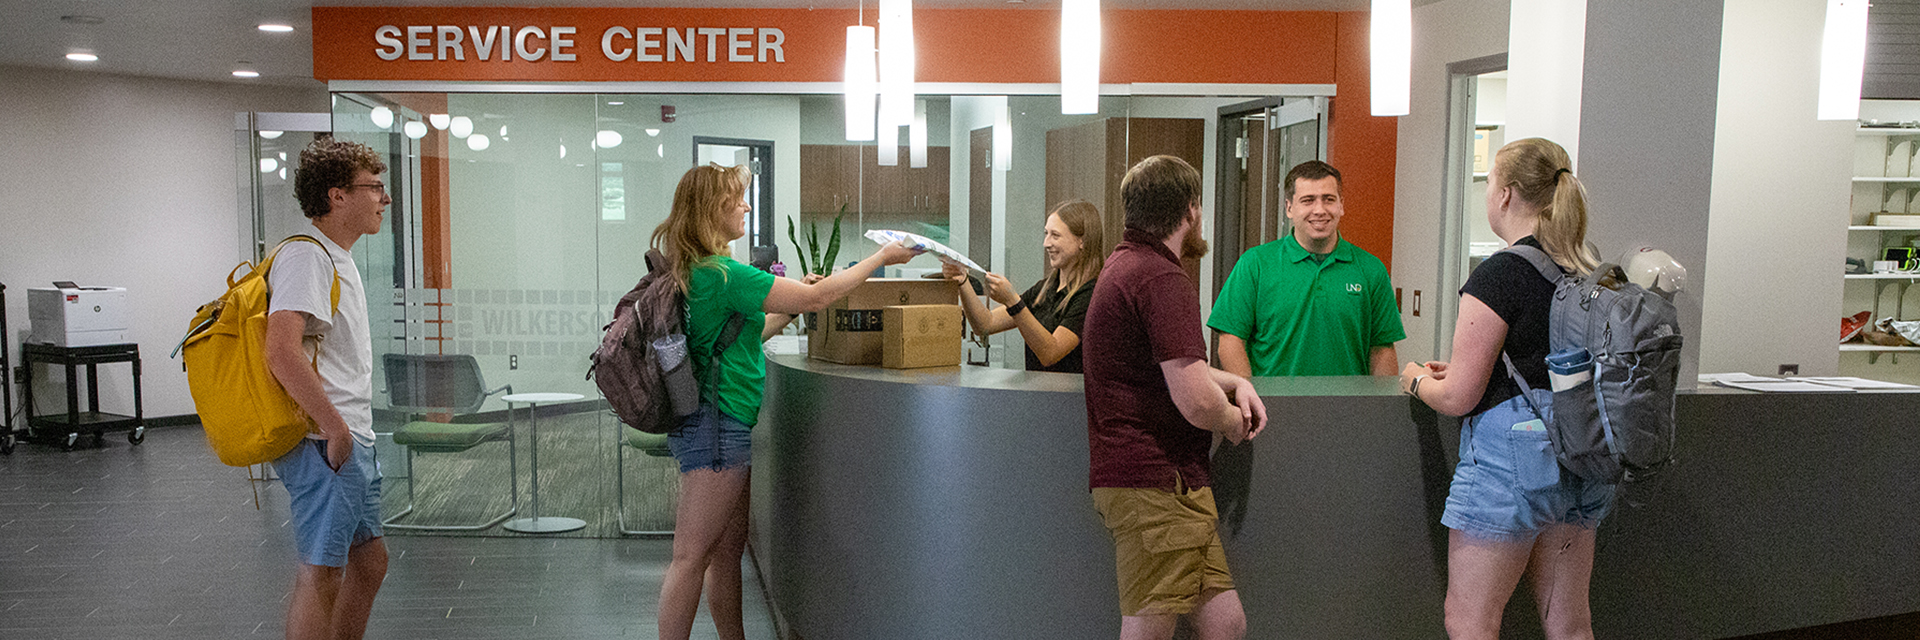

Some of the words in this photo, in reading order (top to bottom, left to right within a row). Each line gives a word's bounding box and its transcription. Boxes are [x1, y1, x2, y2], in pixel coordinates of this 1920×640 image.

[374, 25, 577, 62] SERVICE
[601, 25, 786, 63] CENTER
[481, 309, 613, 336] WILKERSO
